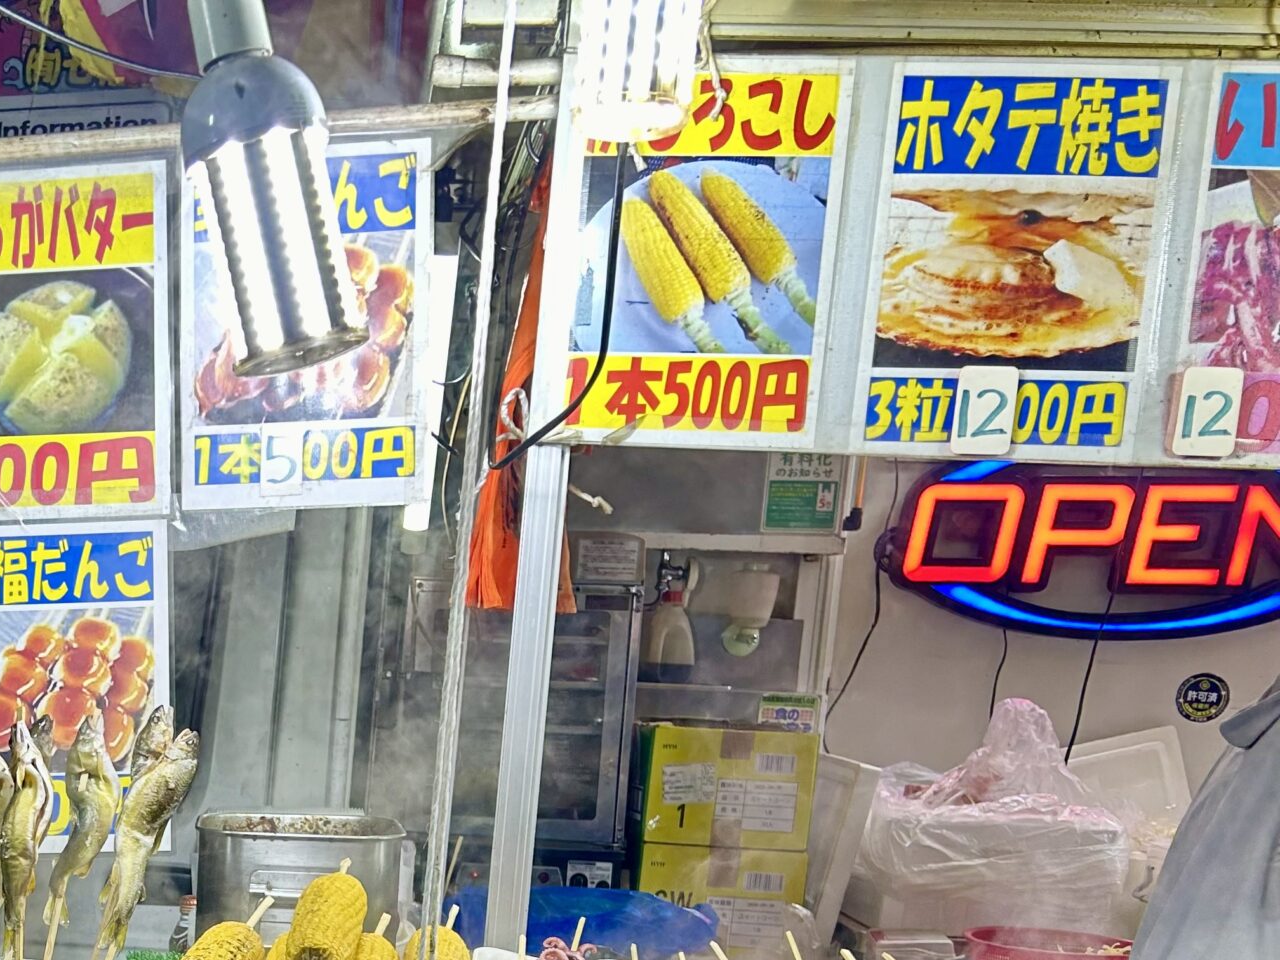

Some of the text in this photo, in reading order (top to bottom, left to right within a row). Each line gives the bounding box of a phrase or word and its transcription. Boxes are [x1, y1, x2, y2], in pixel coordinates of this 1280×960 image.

[586, 78, 836, 154] ろこし
[895, 78, 1163, 177] ホタテ焼き
[566, 357, 810, 433] 1本500円
